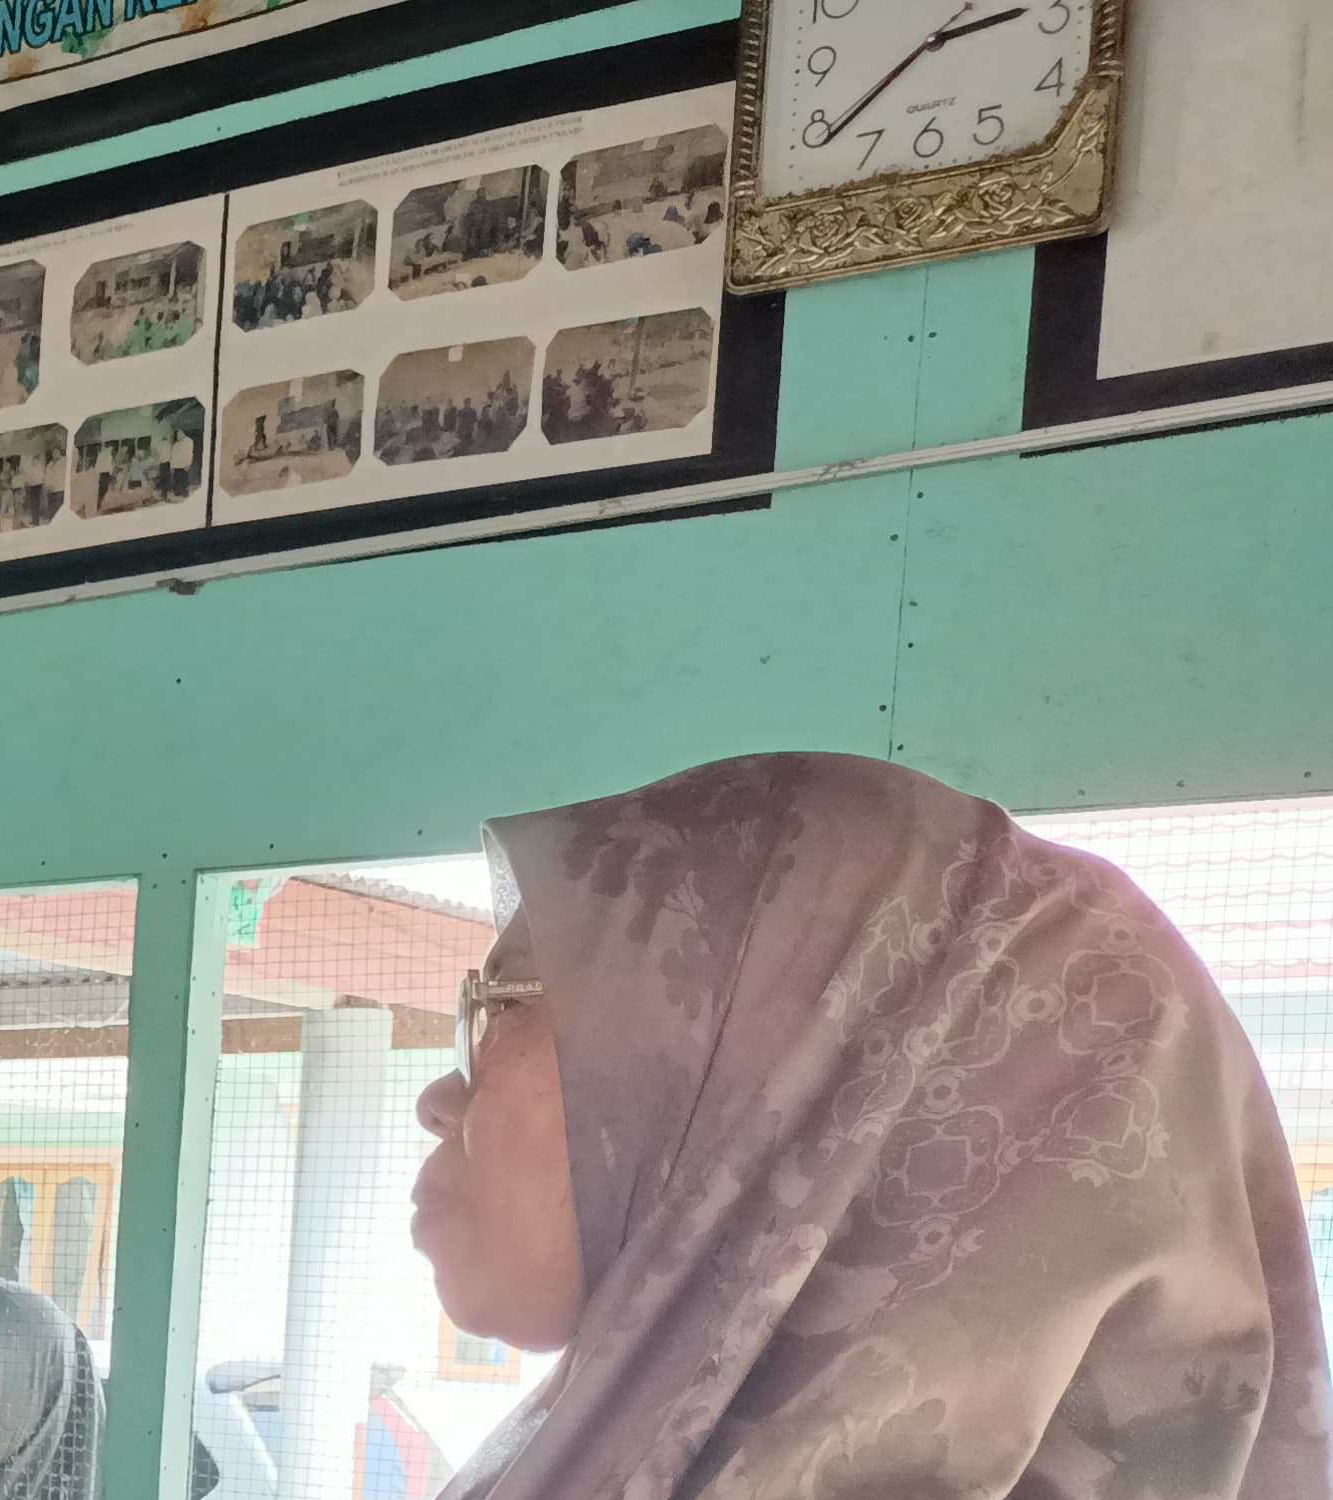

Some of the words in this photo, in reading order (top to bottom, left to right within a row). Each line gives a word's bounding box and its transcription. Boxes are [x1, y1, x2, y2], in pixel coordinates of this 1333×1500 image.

[1038, 0, 1070, 34] 3
[808, 46, 836, 87] 9
[1034, 57, 1065, 97] 4
[906, 97, 957, 114] QUARTZ
[973, 104, 1004, 146] 5
[802, 109, 832, 148] 8
[913, 117, 944, 158] 6
[856, 129, 886, 171] 7
[506, 982, 543, 992] PRAD
